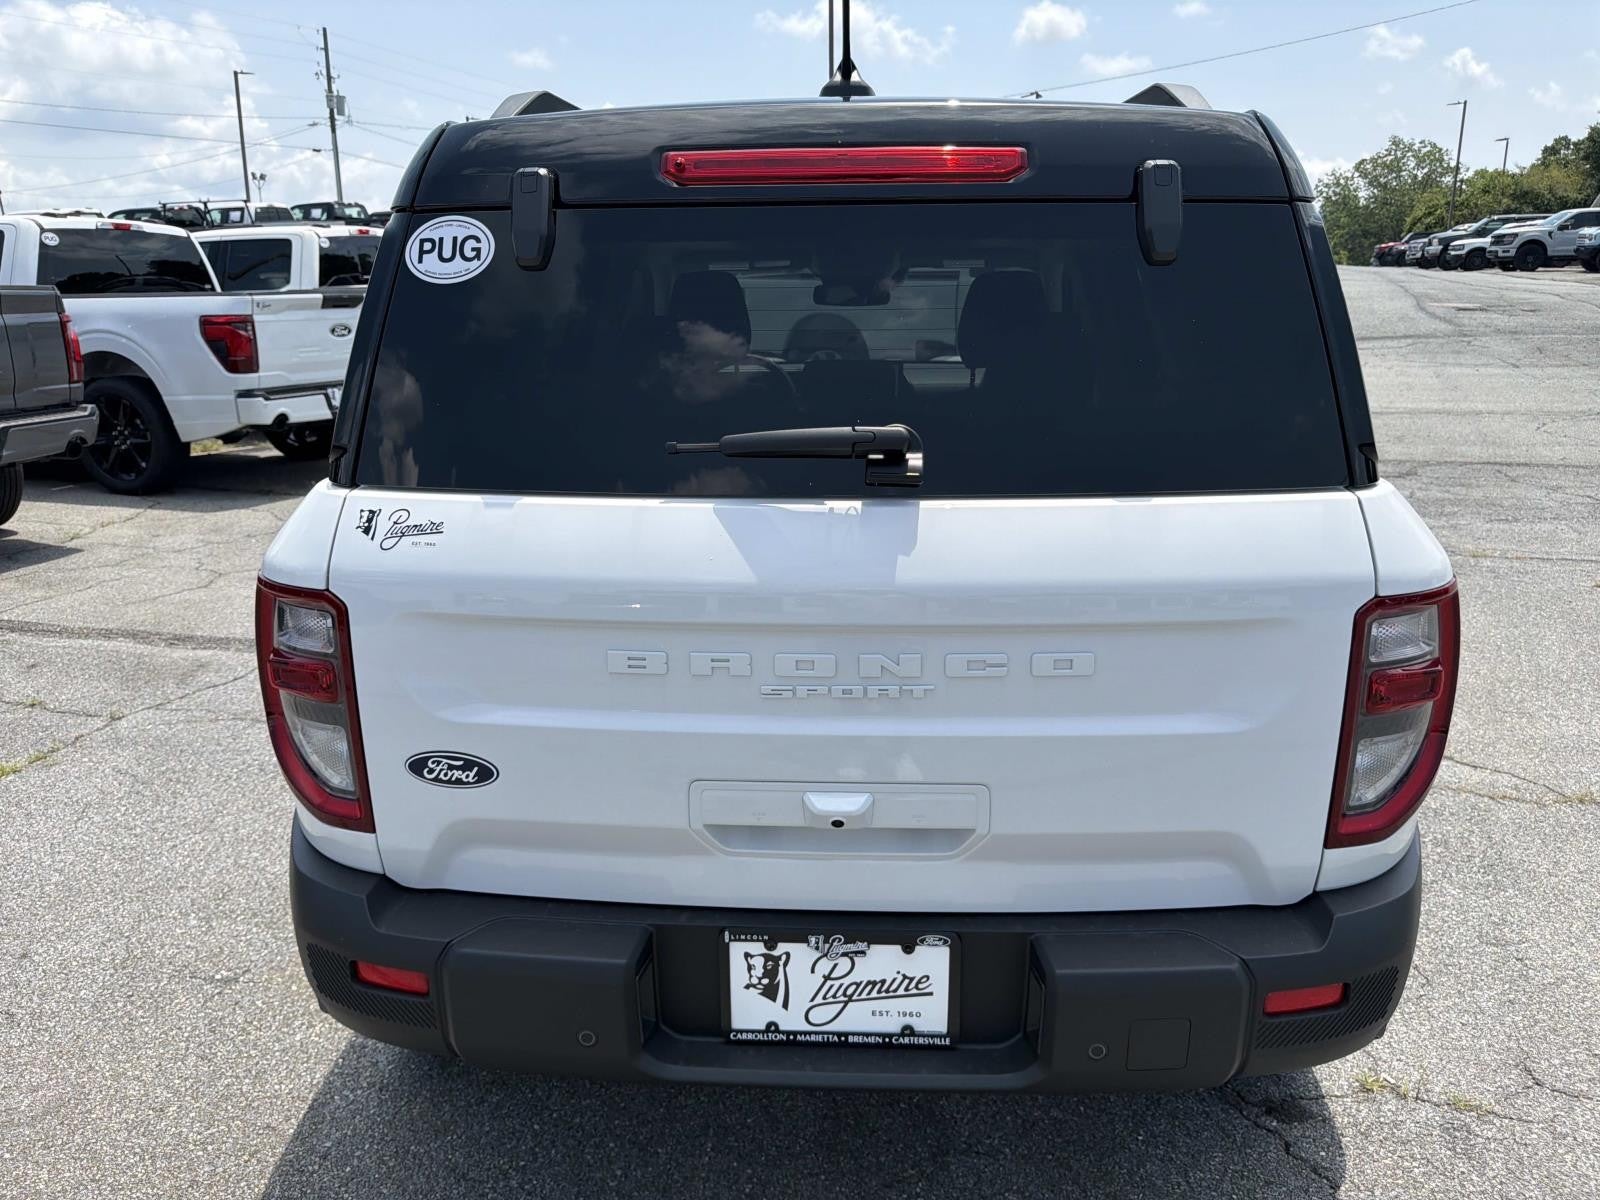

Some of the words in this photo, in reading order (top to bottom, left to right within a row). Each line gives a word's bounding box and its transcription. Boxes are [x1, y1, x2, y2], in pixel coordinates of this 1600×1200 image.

[417, 234, 482, 264] PUG
[380, 508, 445, 551] Pugmire
[606, 649, 1096, 679] BRONCO
[759, 684, 936, 699] SPORT
[423, 757, 479, 783] Ford
[827, 934, 870, 960] Pugmire
[923, 937, 944, 946] Ford
[804, 952, 934, 1027] Pugmire
[871, 1009, 893, 1018] EST.
[897, 1010, 922, 1018] 1960
[729, 1031, 787, 1041] CARROLLTON
[796, 1033, 839, 1043] MARIETTA
[848, 1035, 883, 1044] BREMEN
[892, 1036, 951, 1046] CARTERSVILLE
